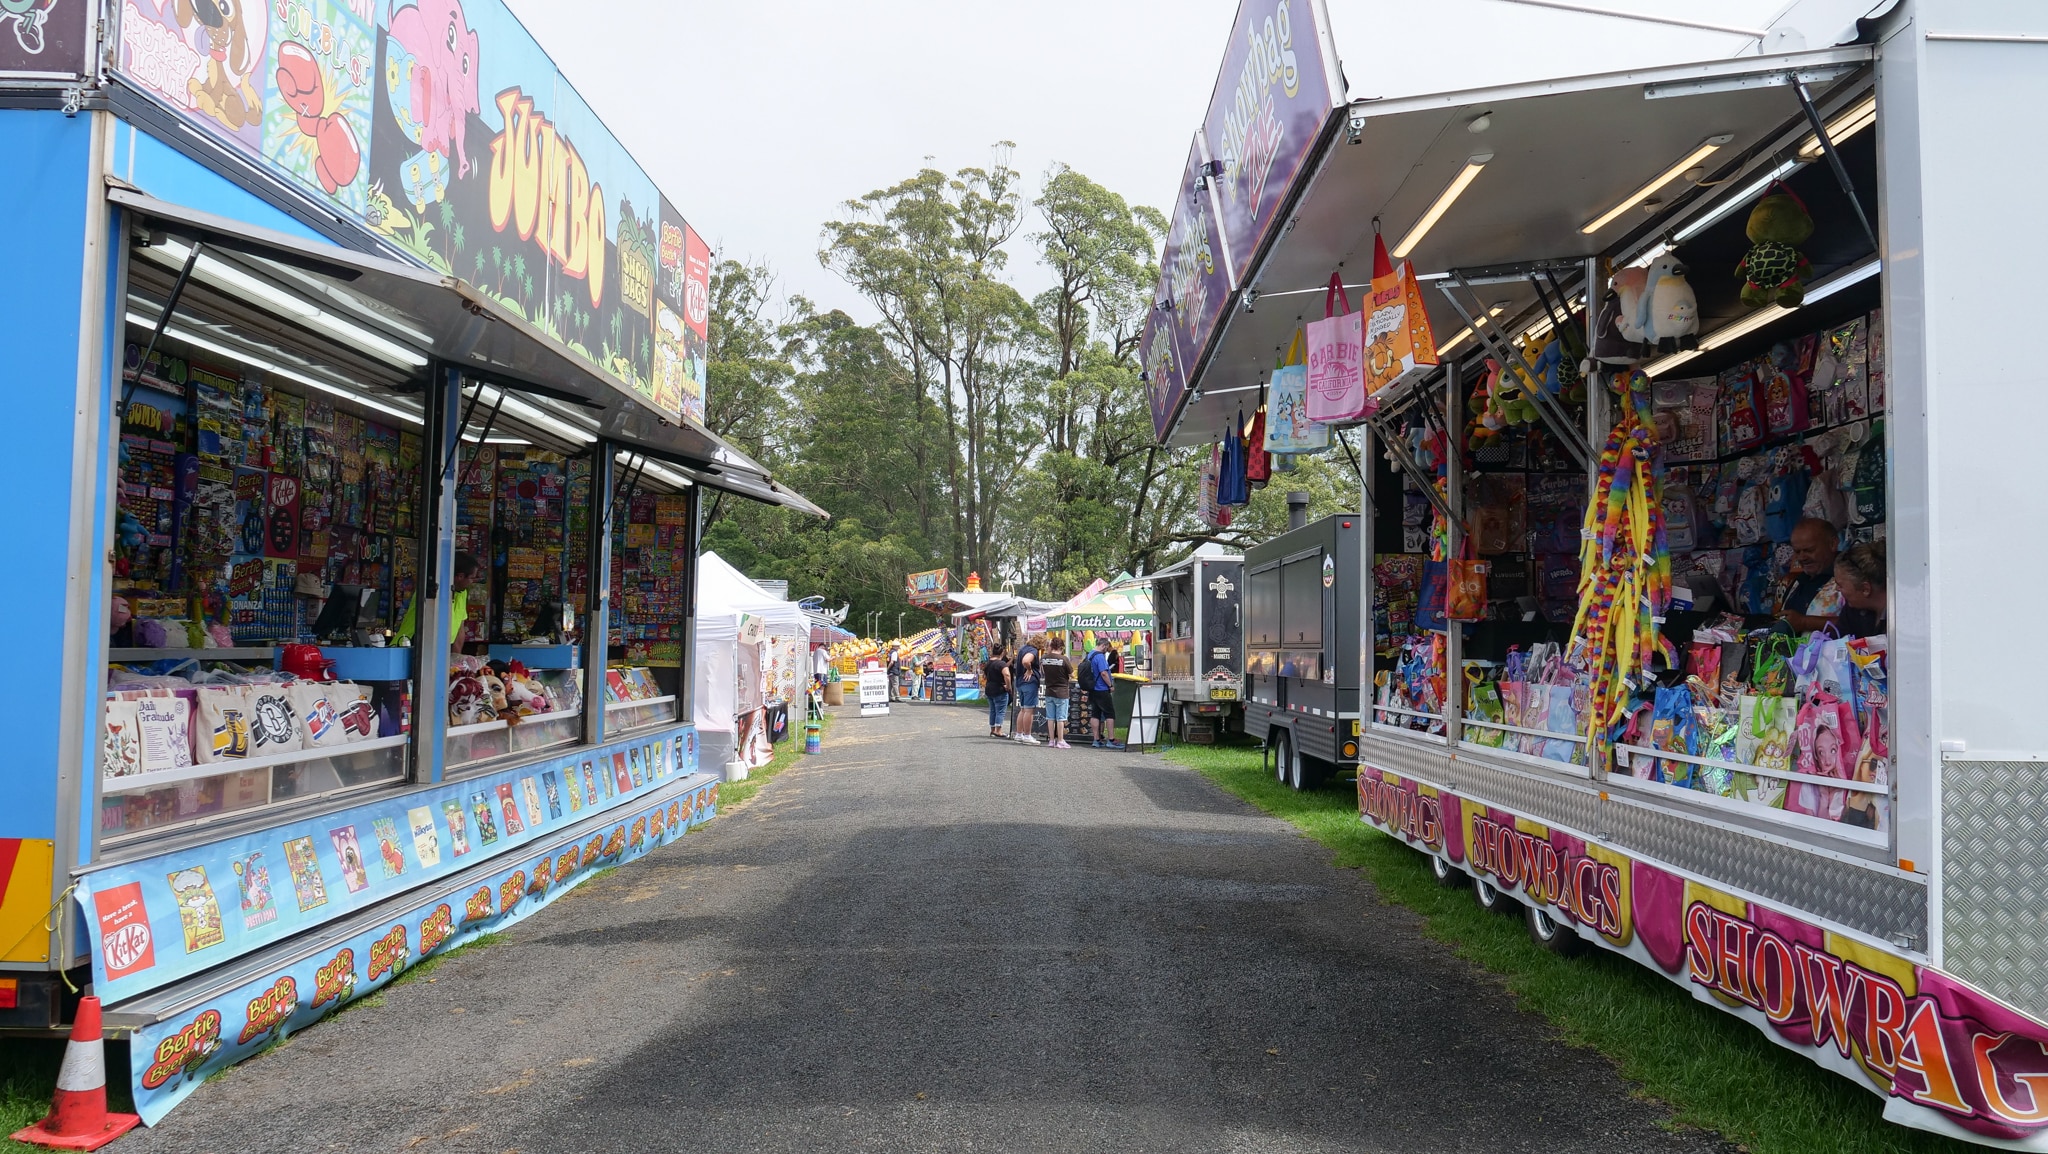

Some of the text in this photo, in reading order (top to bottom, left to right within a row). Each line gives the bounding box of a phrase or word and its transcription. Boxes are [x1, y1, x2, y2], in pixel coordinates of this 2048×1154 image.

[489, 86, 605, 308] JUMBO
[623, 251, 649, 288] SHOW
[623, 276, 647, 308] BAGS
[1310, 342, 1360, 370] BARBIE
[1318, 376, 1352, 391] CALIFORNIA
[128, 402, 162, 432] JUMBO
[1667, 438, 1704, 451] BUBBLE
[275, 479, 294, 504] KitKat
[359, 536, 381, 562] Yupi
[233, 561, 261, 579] Bertie
[1384, 563, 1415, 574] SOUR
[230, 579, 251, 593] Beetle
[1071, 614, 1111, 628] Nath's
[1115, 615, 1147, 627] Corn
[265, 707, 281, 732] B
[1358, 774, 1442, 847] SHOWBAGS
[501, 873, 522, 899] Bertie
[1472, 813, 1622, 936] SHOWBAGS
[467, 888, 488, 914] Bertie
[103, 909, 117, 922] Have
[114, 914, 128, 925] have
[245, 907, 278, 927] PRETTY PONY
[421, 906, 446, 937] Bertie
[111, 926, 145, 966] KitKat
[371, 928, 402, 961] Bertie
[317, 951, 349, 989] Bertie
[248, 979, 291, 1023] Bertie
[159, 1013, 216, 1063] Bertie
[243, 1010, 277, 1039] Beetle
